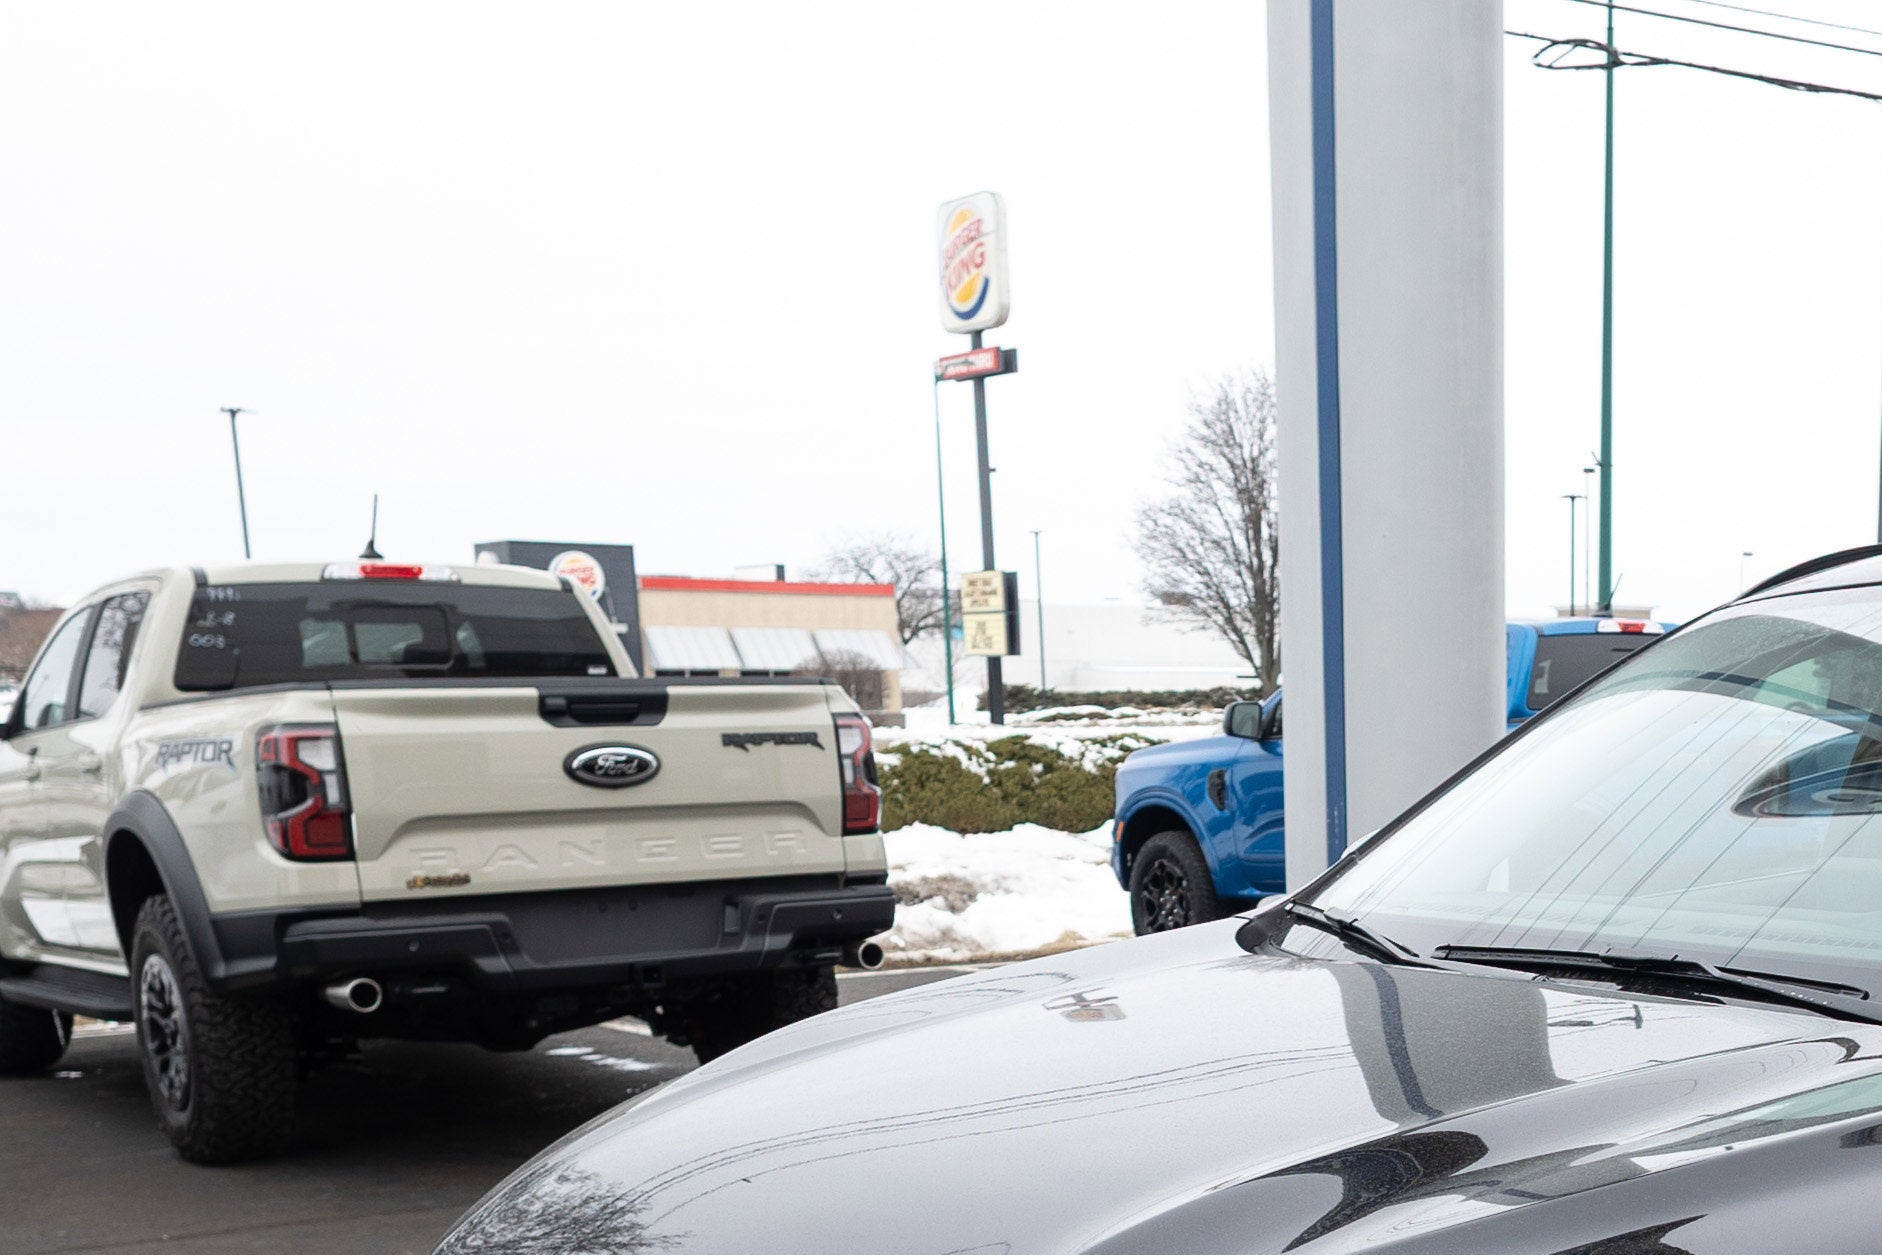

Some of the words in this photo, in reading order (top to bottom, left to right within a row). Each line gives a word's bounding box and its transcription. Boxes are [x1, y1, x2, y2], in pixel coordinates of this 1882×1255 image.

[945, 240, 986, 292] KING
[155, 736, 237, 771] RAPTOR
[720, 730, 826, 753] RAPTOR
[594, 753, 639, 776] Ford
[407, 829, 809, 876] RANGER
